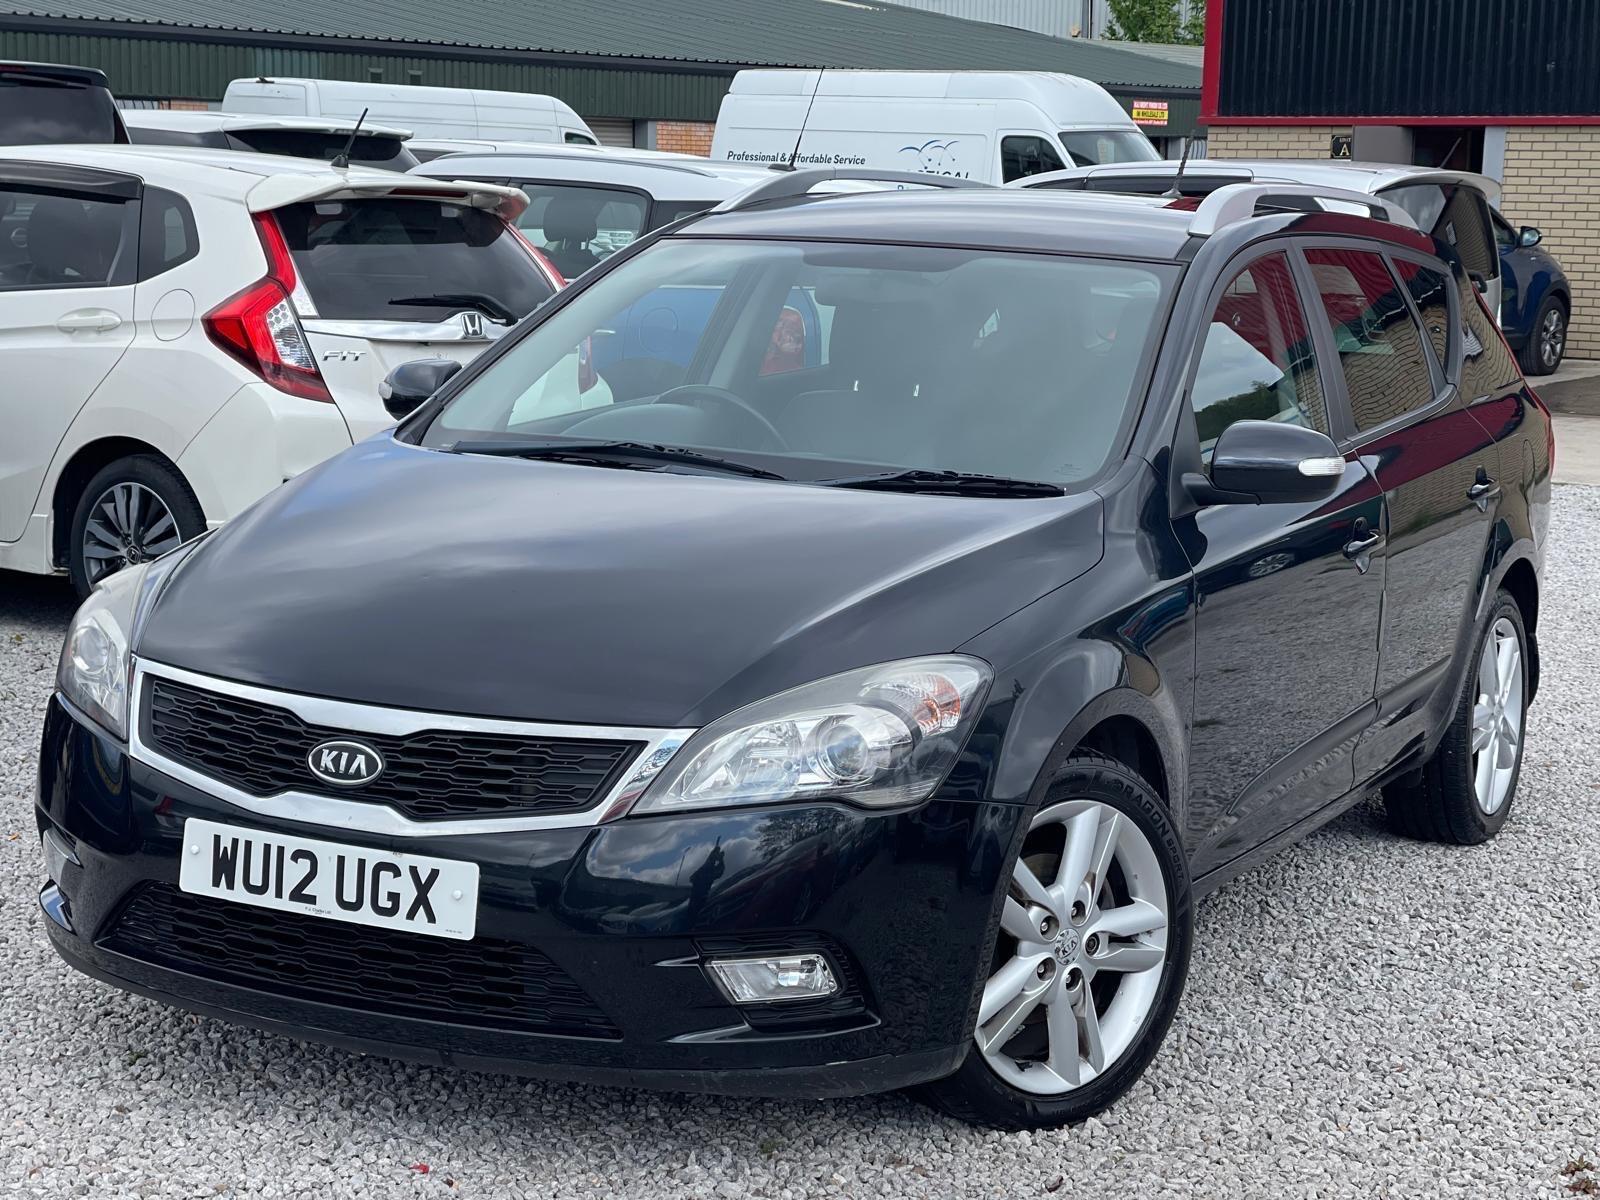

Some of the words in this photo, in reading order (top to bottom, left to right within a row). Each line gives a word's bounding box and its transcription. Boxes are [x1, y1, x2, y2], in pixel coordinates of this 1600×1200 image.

[727, 150, 779, 162] Professional
[780, 152, 787, 162] &
[834, 154, 866, 165] Service
[1339, 143, 1350, 156] A
[322, 350, 367, 361] FIT
[320, 748, 367, 777] KIA
[1165, 838, 1184, 880] SPORT
[211, 834, 318, 905] WU12
[335, 854, 440, 924] UGX
[1062, 939, 1077, 956] KIA
